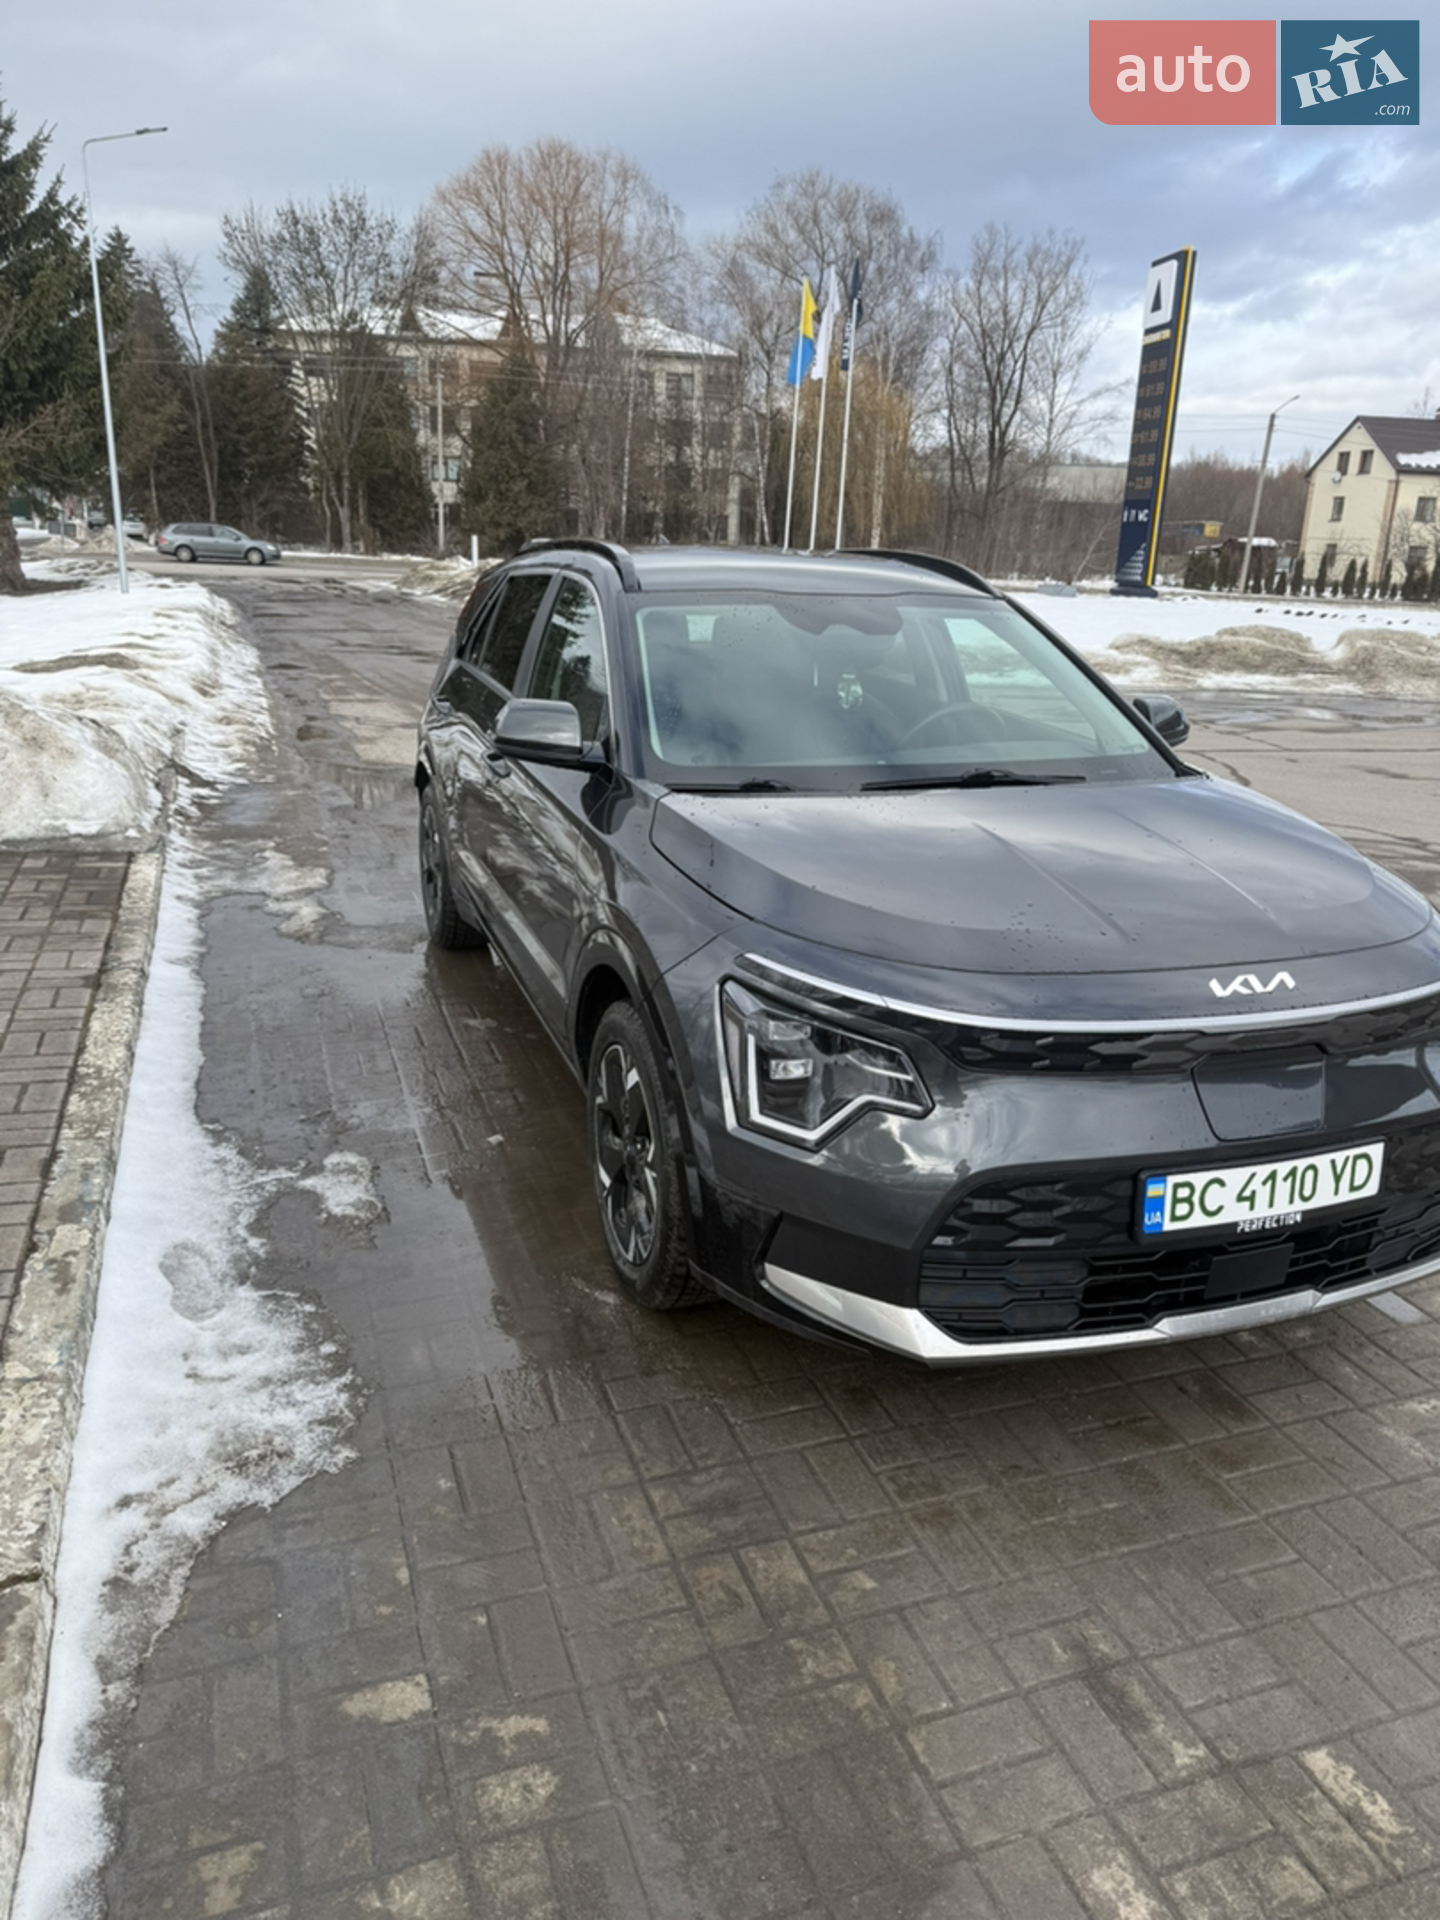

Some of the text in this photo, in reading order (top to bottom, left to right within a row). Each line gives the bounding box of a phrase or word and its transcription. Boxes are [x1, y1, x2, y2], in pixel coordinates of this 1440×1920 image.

[1169, 1152, 1374, 1223] BC 4110 YD
[1144, 1211, 1163, 1226] UA
[1236, 1212, 1302, 1233] PERFECTION
